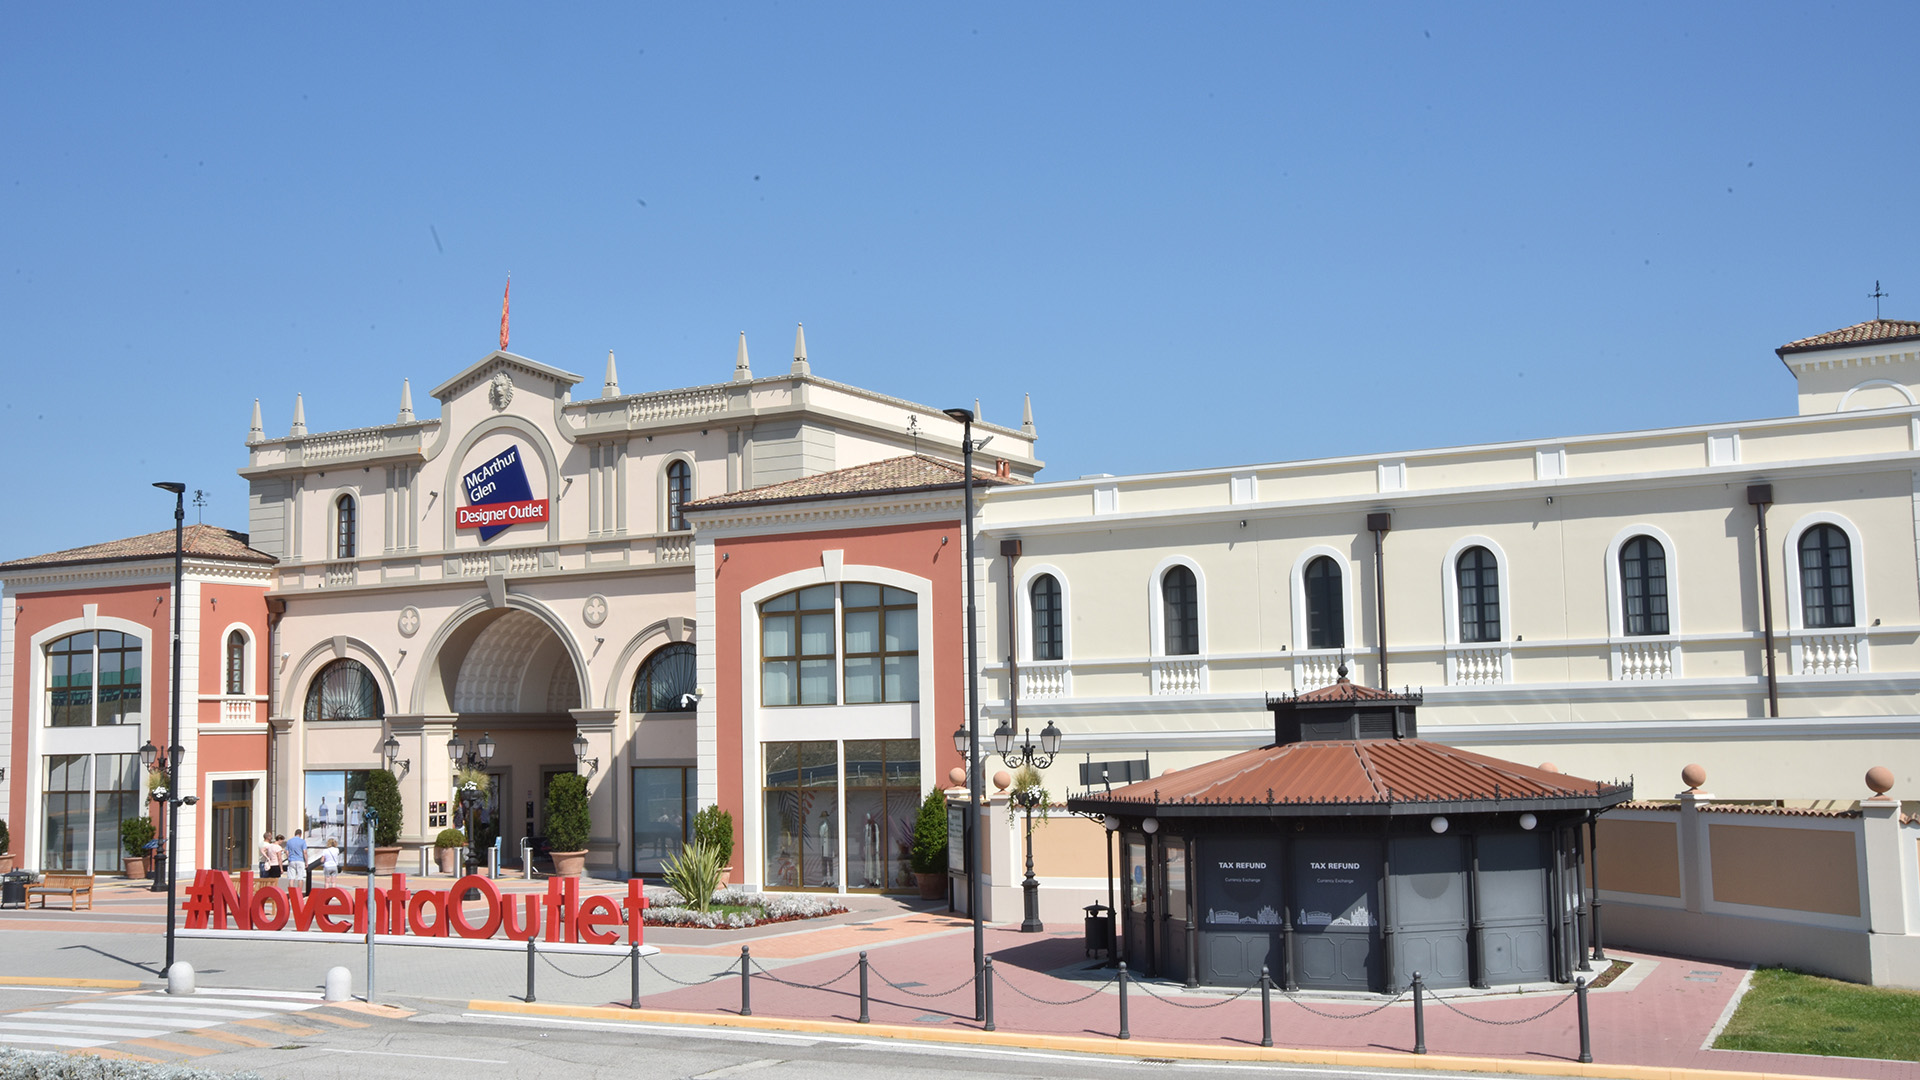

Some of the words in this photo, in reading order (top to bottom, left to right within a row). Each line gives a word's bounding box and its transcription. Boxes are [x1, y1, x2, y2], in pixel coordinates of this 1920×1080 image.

[466, 451, 516, 489] McArthur
[471, 481, 496, 502] Glen
[460, 508, 507, 525] Designer
[508, 503, 543, 519] Outlet
[1328, 862, 1360, 870] REFUND
[182, 869, 650, 946] #NoventaOutlet
